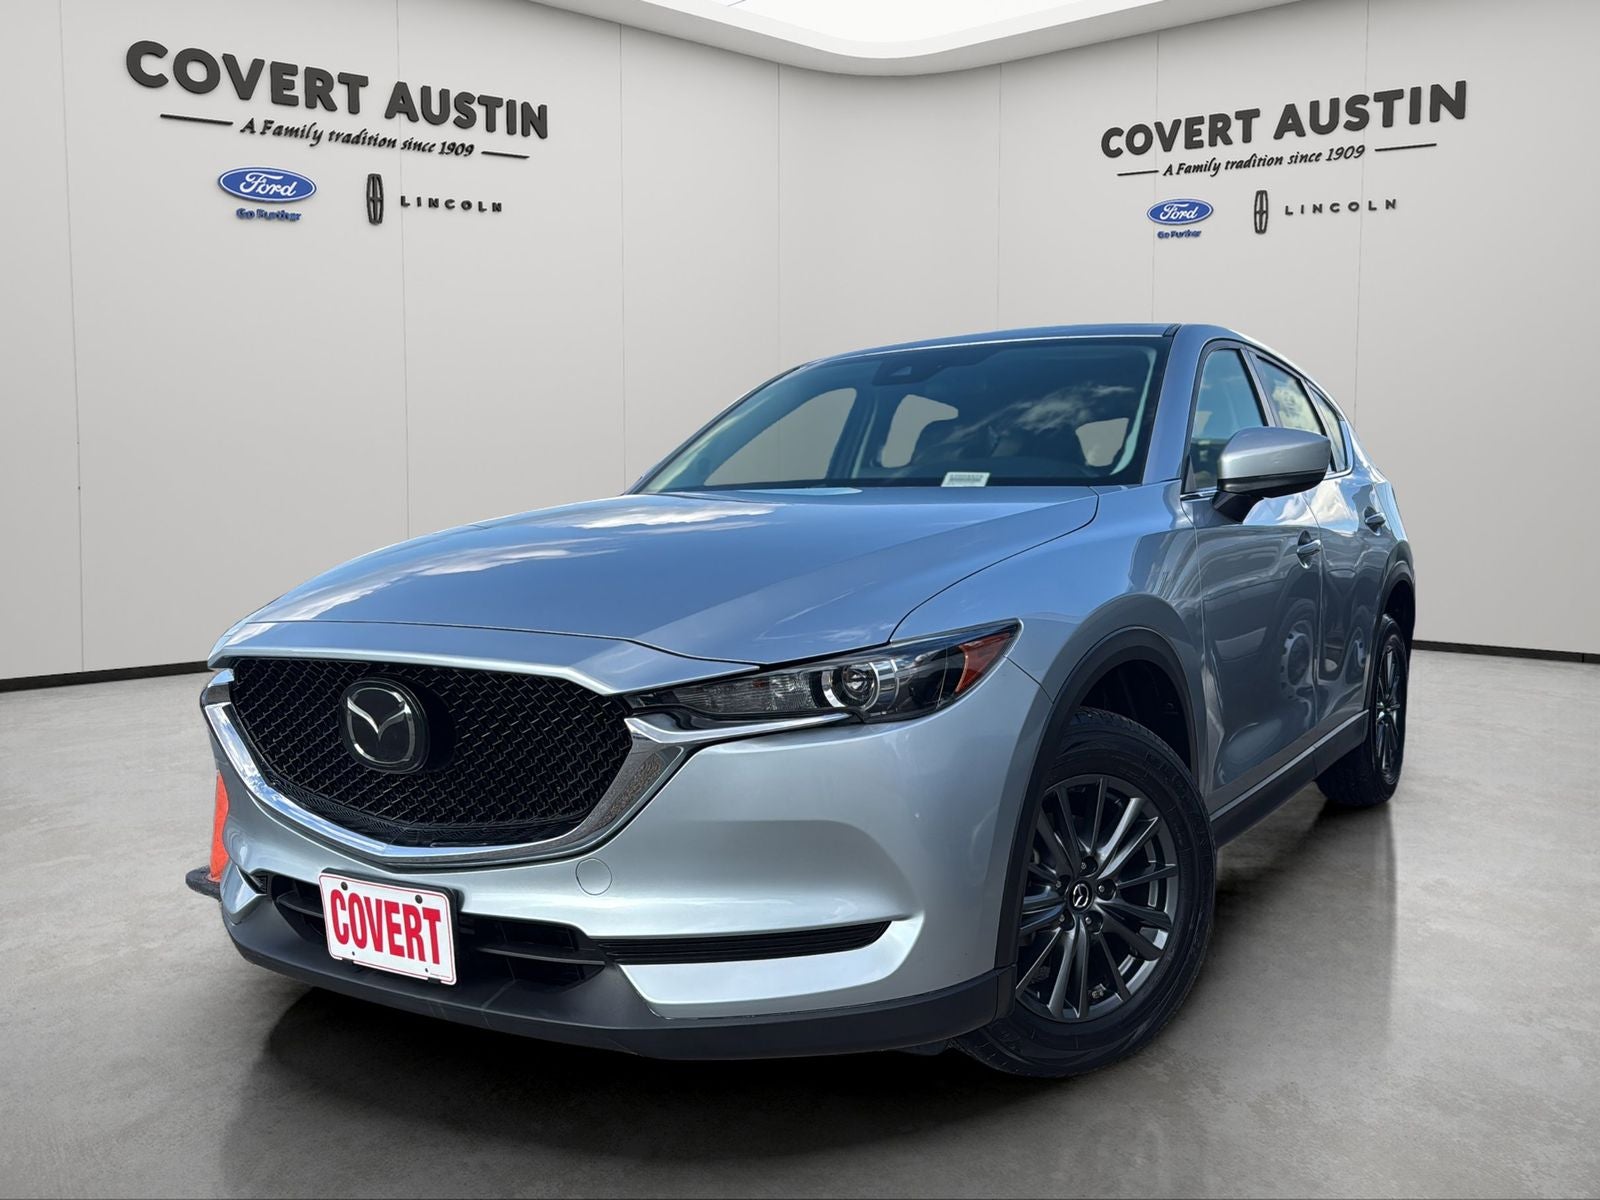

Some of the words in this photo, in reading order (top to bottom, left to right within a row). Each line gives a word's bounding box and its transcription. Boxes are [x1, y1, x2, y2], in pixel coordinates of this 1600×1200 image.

[126, 40, 369, 114] COVERT
[384, 81, 548, 139] AUSTIN
[1100, 108, 1261, 158] COVERT
[1273, 80, 1467, 141] AUSTIN
[240, 117, 256, 135] A
[260, 119, 324, 147] Family
[327, 128, 397, 149] tradition
[400, 137, 436, 153] since
[438, 141, 475, 157] 1909
[1163, 163, 1174, 176] A
[1176, 157, 1221, 177] Family
[1224, 153, 1283, 169] tradition
[1287, 151, 1322, 165] since
[1325, 145, 1365, 161] 1909
[239, 172, 298, 197] Ford
[400, 195, 503, 213] LINCOLN
[1160, 203, 1199, 220] Ford
[1285, 198, 1398, 216] LINCOLN
[330, 889, 442, 965] COVERT
